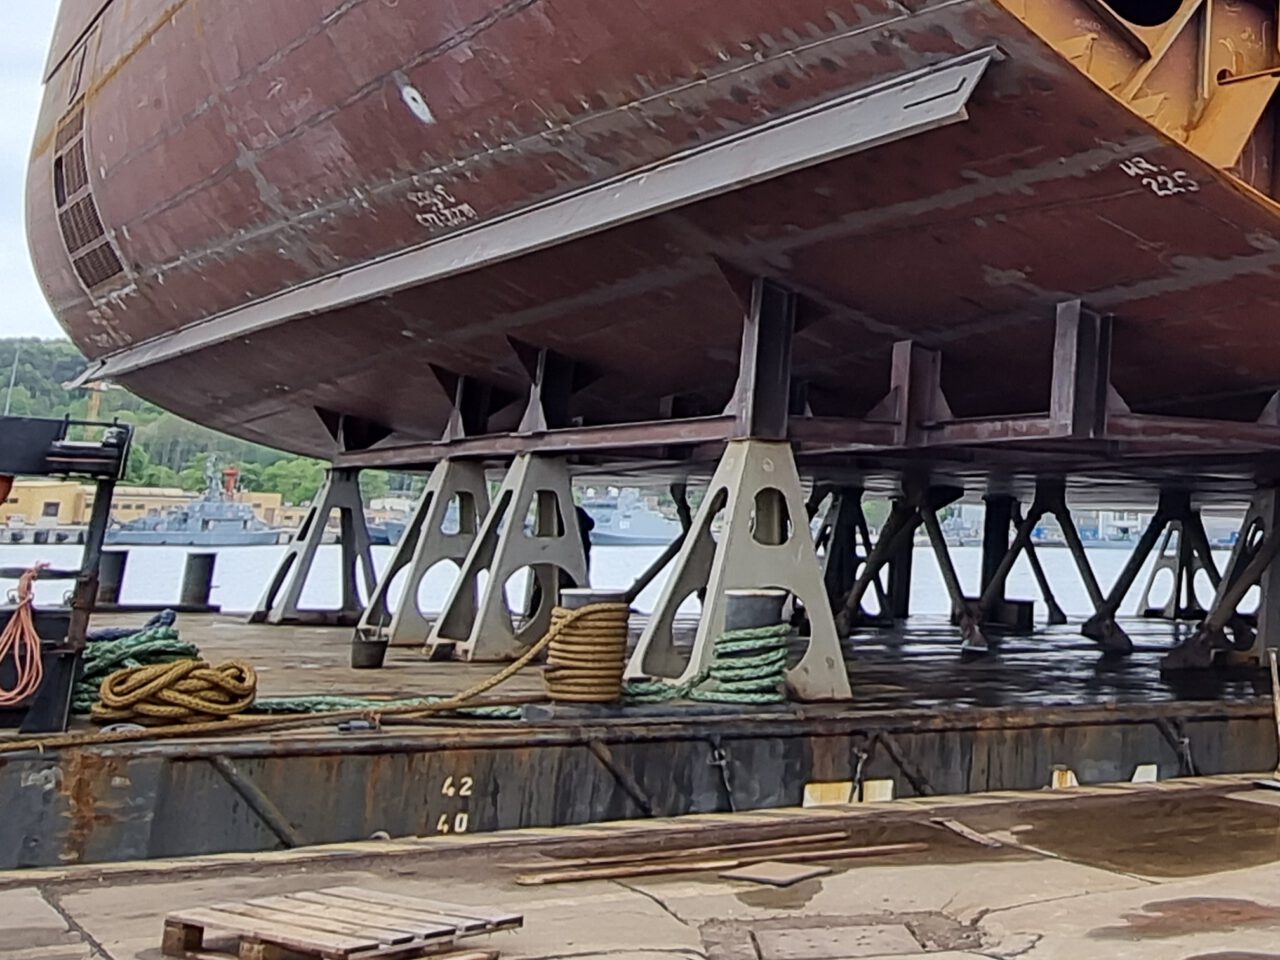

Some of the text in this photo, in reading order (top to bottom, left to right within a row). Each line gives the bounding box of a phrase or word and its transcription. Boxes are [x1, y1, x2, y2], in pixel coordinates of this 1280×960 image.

[1141, 170, 1200, 196] 225
[441, 775, 474, 797] 42
[437, 812, 469, 834] 40
